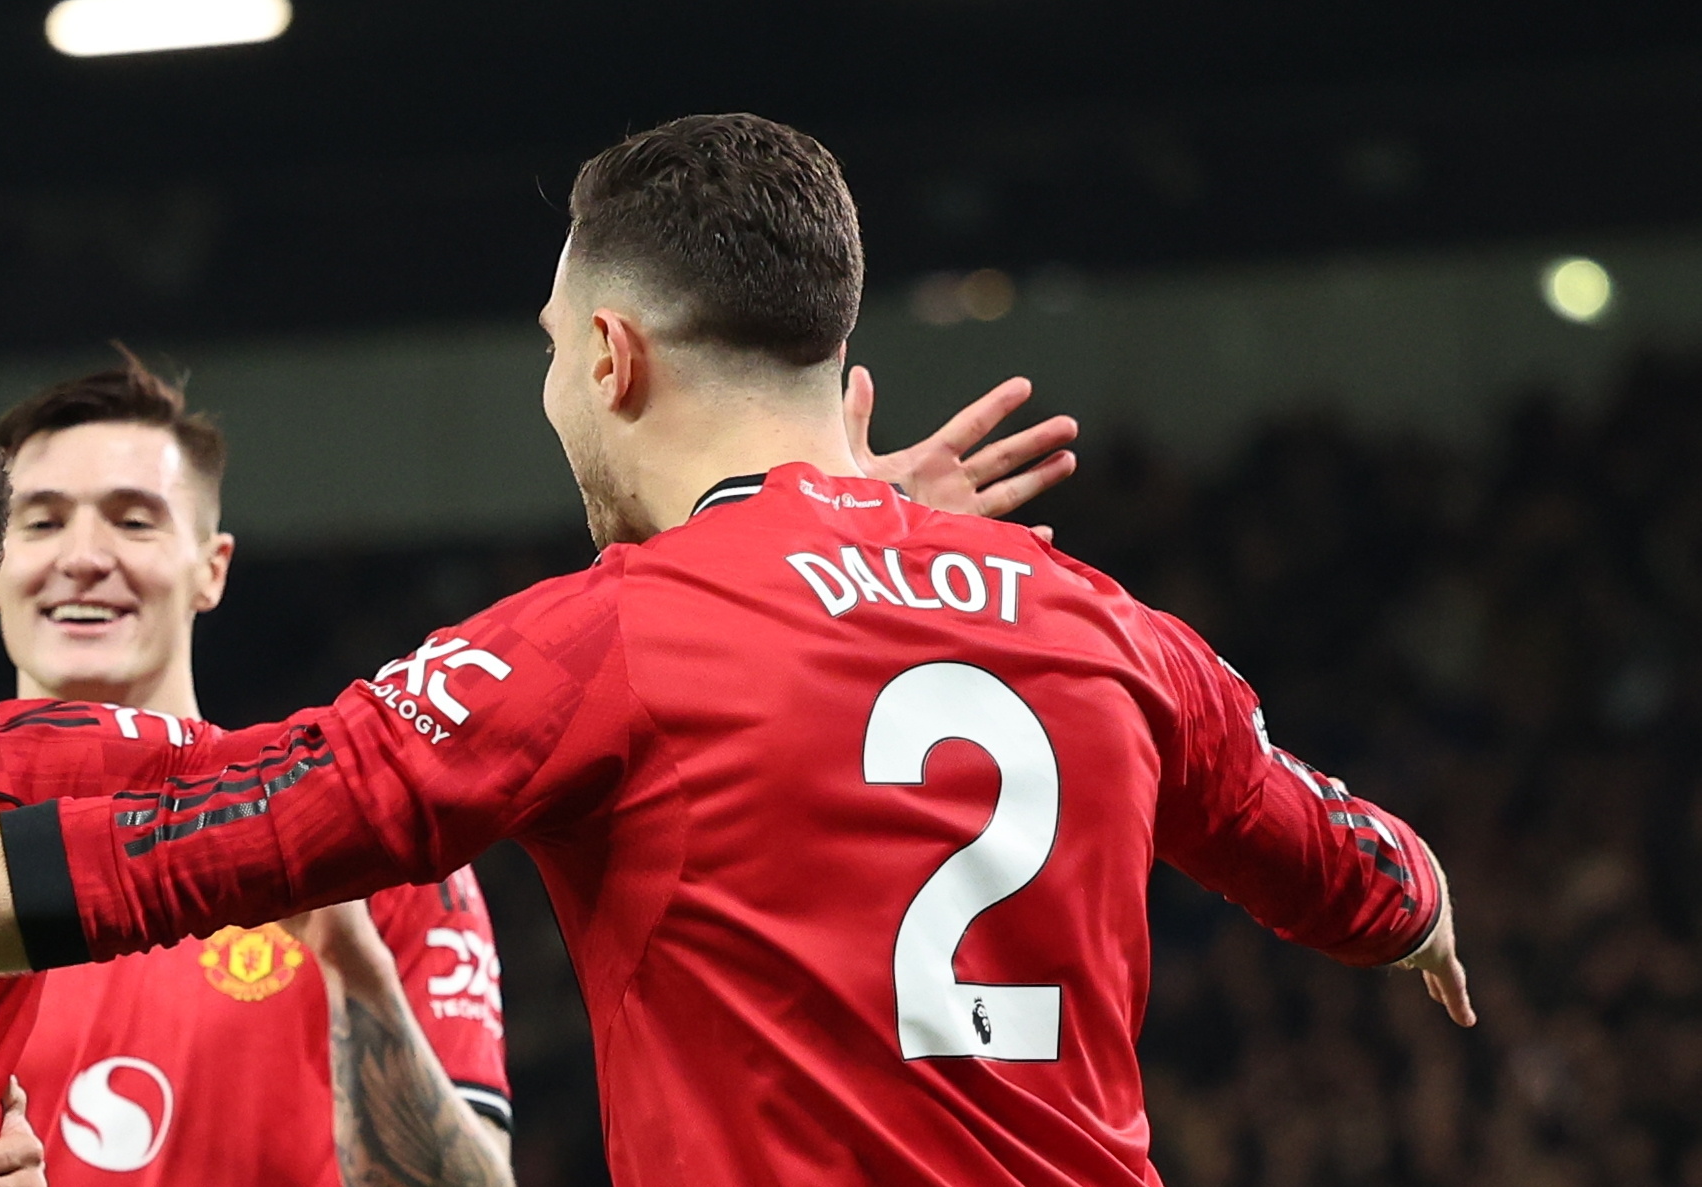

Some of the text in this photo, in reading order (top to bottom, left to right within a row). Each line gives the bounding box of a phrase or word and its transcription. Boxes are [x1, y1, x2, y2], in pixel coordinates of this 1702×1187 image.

[784, 545, 1034, 624] DALOT
[362, 679, 451, 745] OLOGY
[861, 660, 1063, 1062] 2
